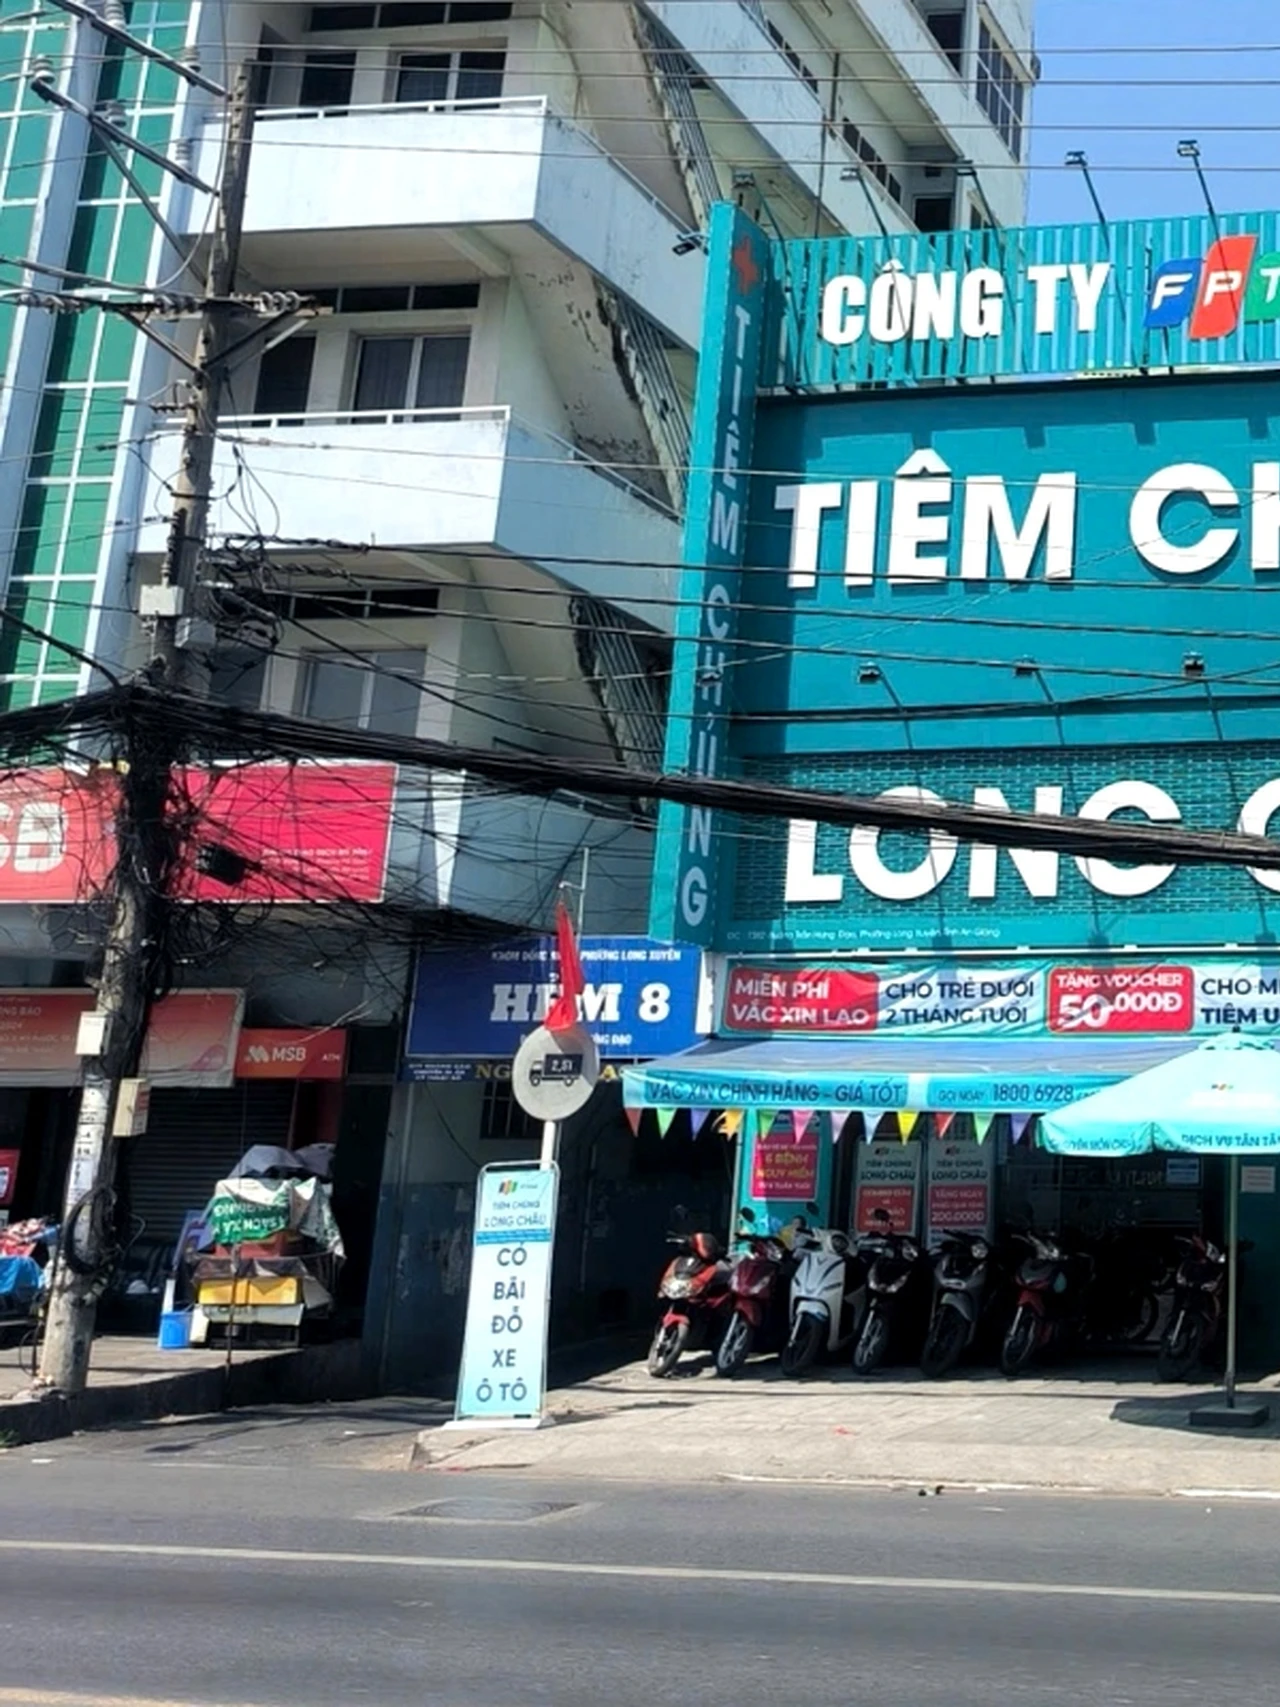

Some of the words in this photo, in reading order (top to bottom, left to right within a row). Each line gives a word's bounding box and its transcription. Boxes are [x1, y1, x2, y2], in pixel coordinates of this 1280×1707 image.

[822, 258, 1004, 345] CÔNG
[1028, 262, 1111, 333] TY
[711, 303, 752, 556] TIÊM
[774, 449, 1077, 589] TIÊM
[0, 801, 68, 873] B
[621, 949, 647, 961] LONG
[649, 946, 682, 961] XUYÊN
[735, 973, 786, 997] MIỄN
[792, 976, 830, 998] PHÍ
[885, 981, 932, 998] CHO
[937, 976, 976, 998] TRẺ
[980, 976, 1034, 998] DƯỚI
[1056, 971, 1101, 991] TẶNG
[1103, 973, 1183, 987] VOUCHER
[1201, 978, 1252, 995] CHO
[639, 983, 671, 1023] 8
[885, 1009, 897, 1023] 2
[900, 1003, 973, 1023] THÁNG
[979, 999, 1027, 1023] TUỔI
[1201, 1003, 1257, 1024] TIÊM
[779, 1006, 817, 1023] XIN
[823, 1008, 870, 1025] LAO
[272, 1047, 306, 1062] MSB
[687, 1082, 715, 1100] XIN
[718, 1079, 768, 1102] CHÍNH
[835, 1079, 863, 1102] GIÁ
[869, 1077, 903, 1103] TỐT
[993, 1084, 1029, 1102] 1800
[1034, 1084, 1074, 1102] 6928
[497, 1241, 527, 1266] CÓ
[493, 1276, 525, 1300] BÃI
[491, 1306, 523, 1333] ĐỖ
[492, 1349, 516, 1368] XE
[476, 1379, 493, 1403] Ô
[499, 1377, 527, 1401] TÔ
